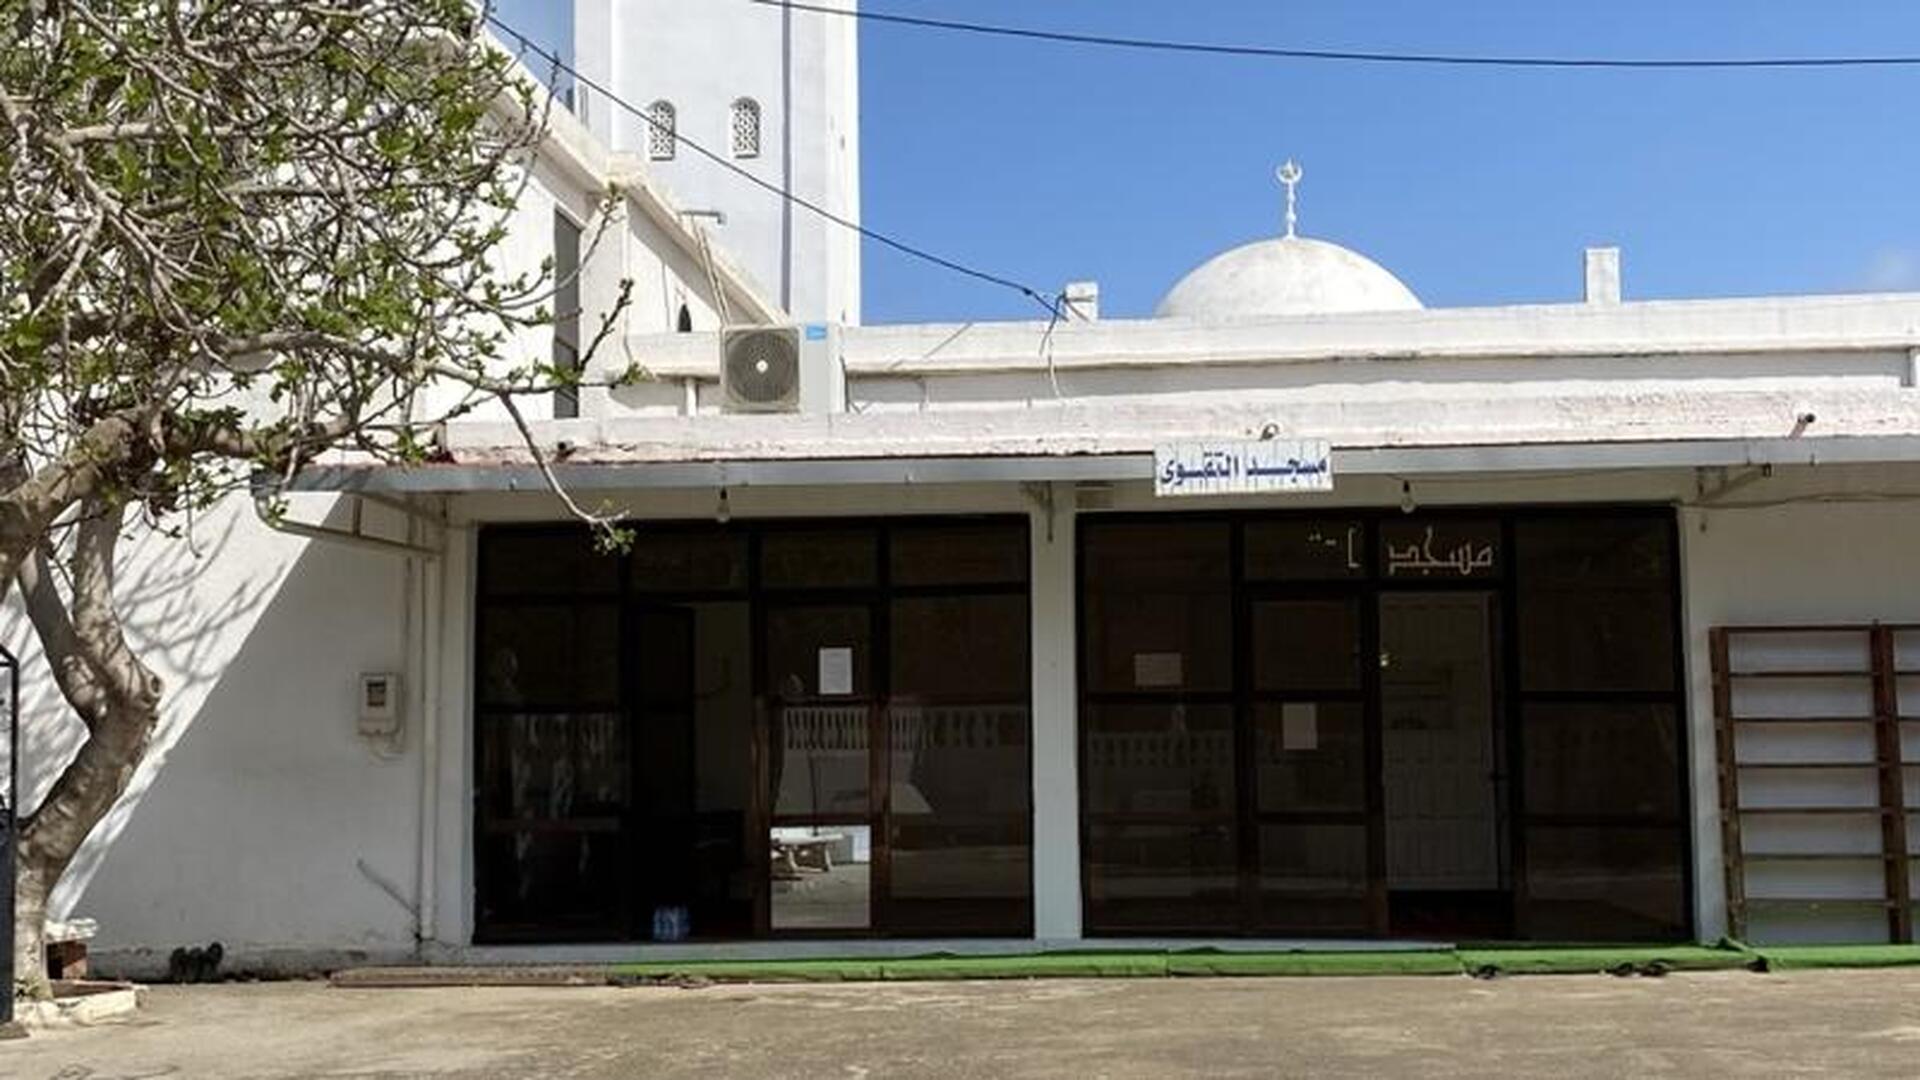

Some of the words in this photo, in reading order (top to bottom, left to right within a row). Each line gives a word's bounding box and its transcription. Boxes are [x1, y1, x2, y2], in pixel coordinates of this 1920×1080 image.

[1160, 452, 1240, 486] التقوى
[1246, 456, 1327, 483] مسجد
[1387, 525, 1493, 576] مسجد
